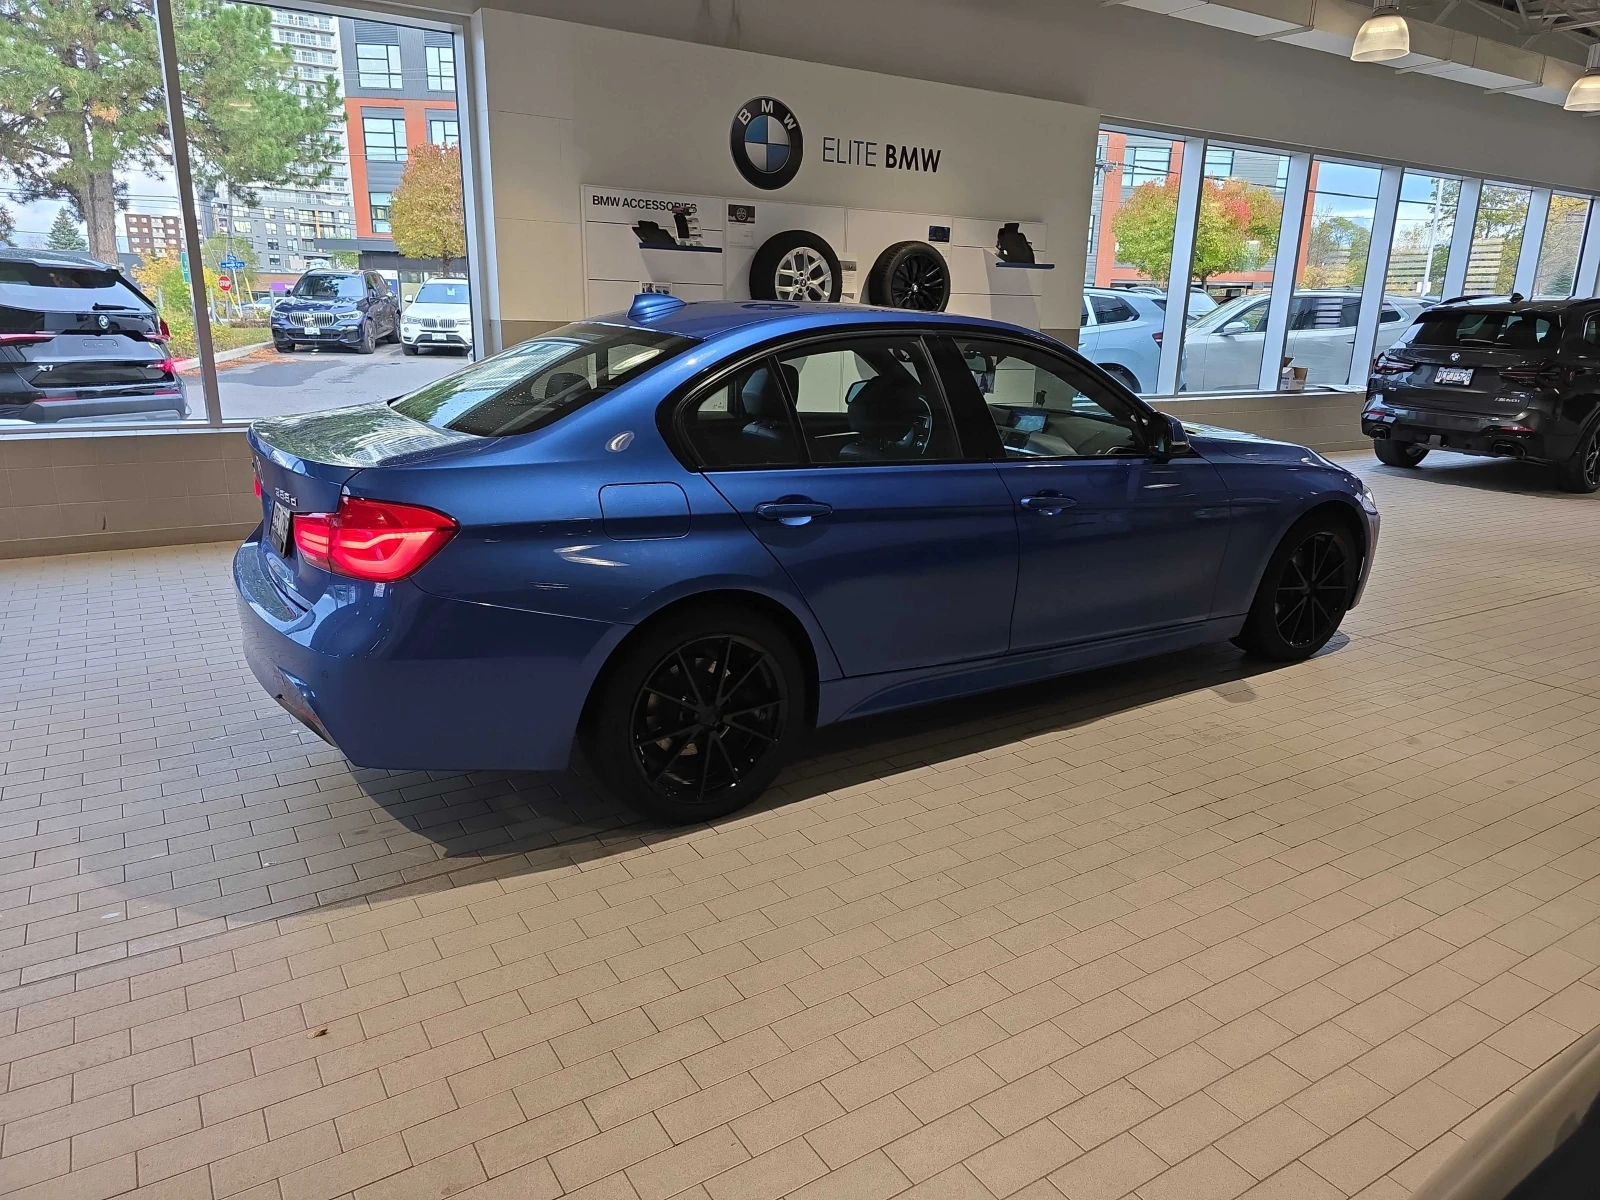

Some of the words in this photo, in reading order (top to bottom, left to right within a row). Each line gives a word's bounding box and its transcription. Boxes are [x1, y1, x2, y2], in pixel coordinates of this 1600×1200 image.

[737, 99, 797, 130] BMW
[822, 136, 877, 167] ELITE
[885, 144, 942, 173] BMW
[592, 194, 620, 207] BMW
[36, 364, 54, 372] X1
